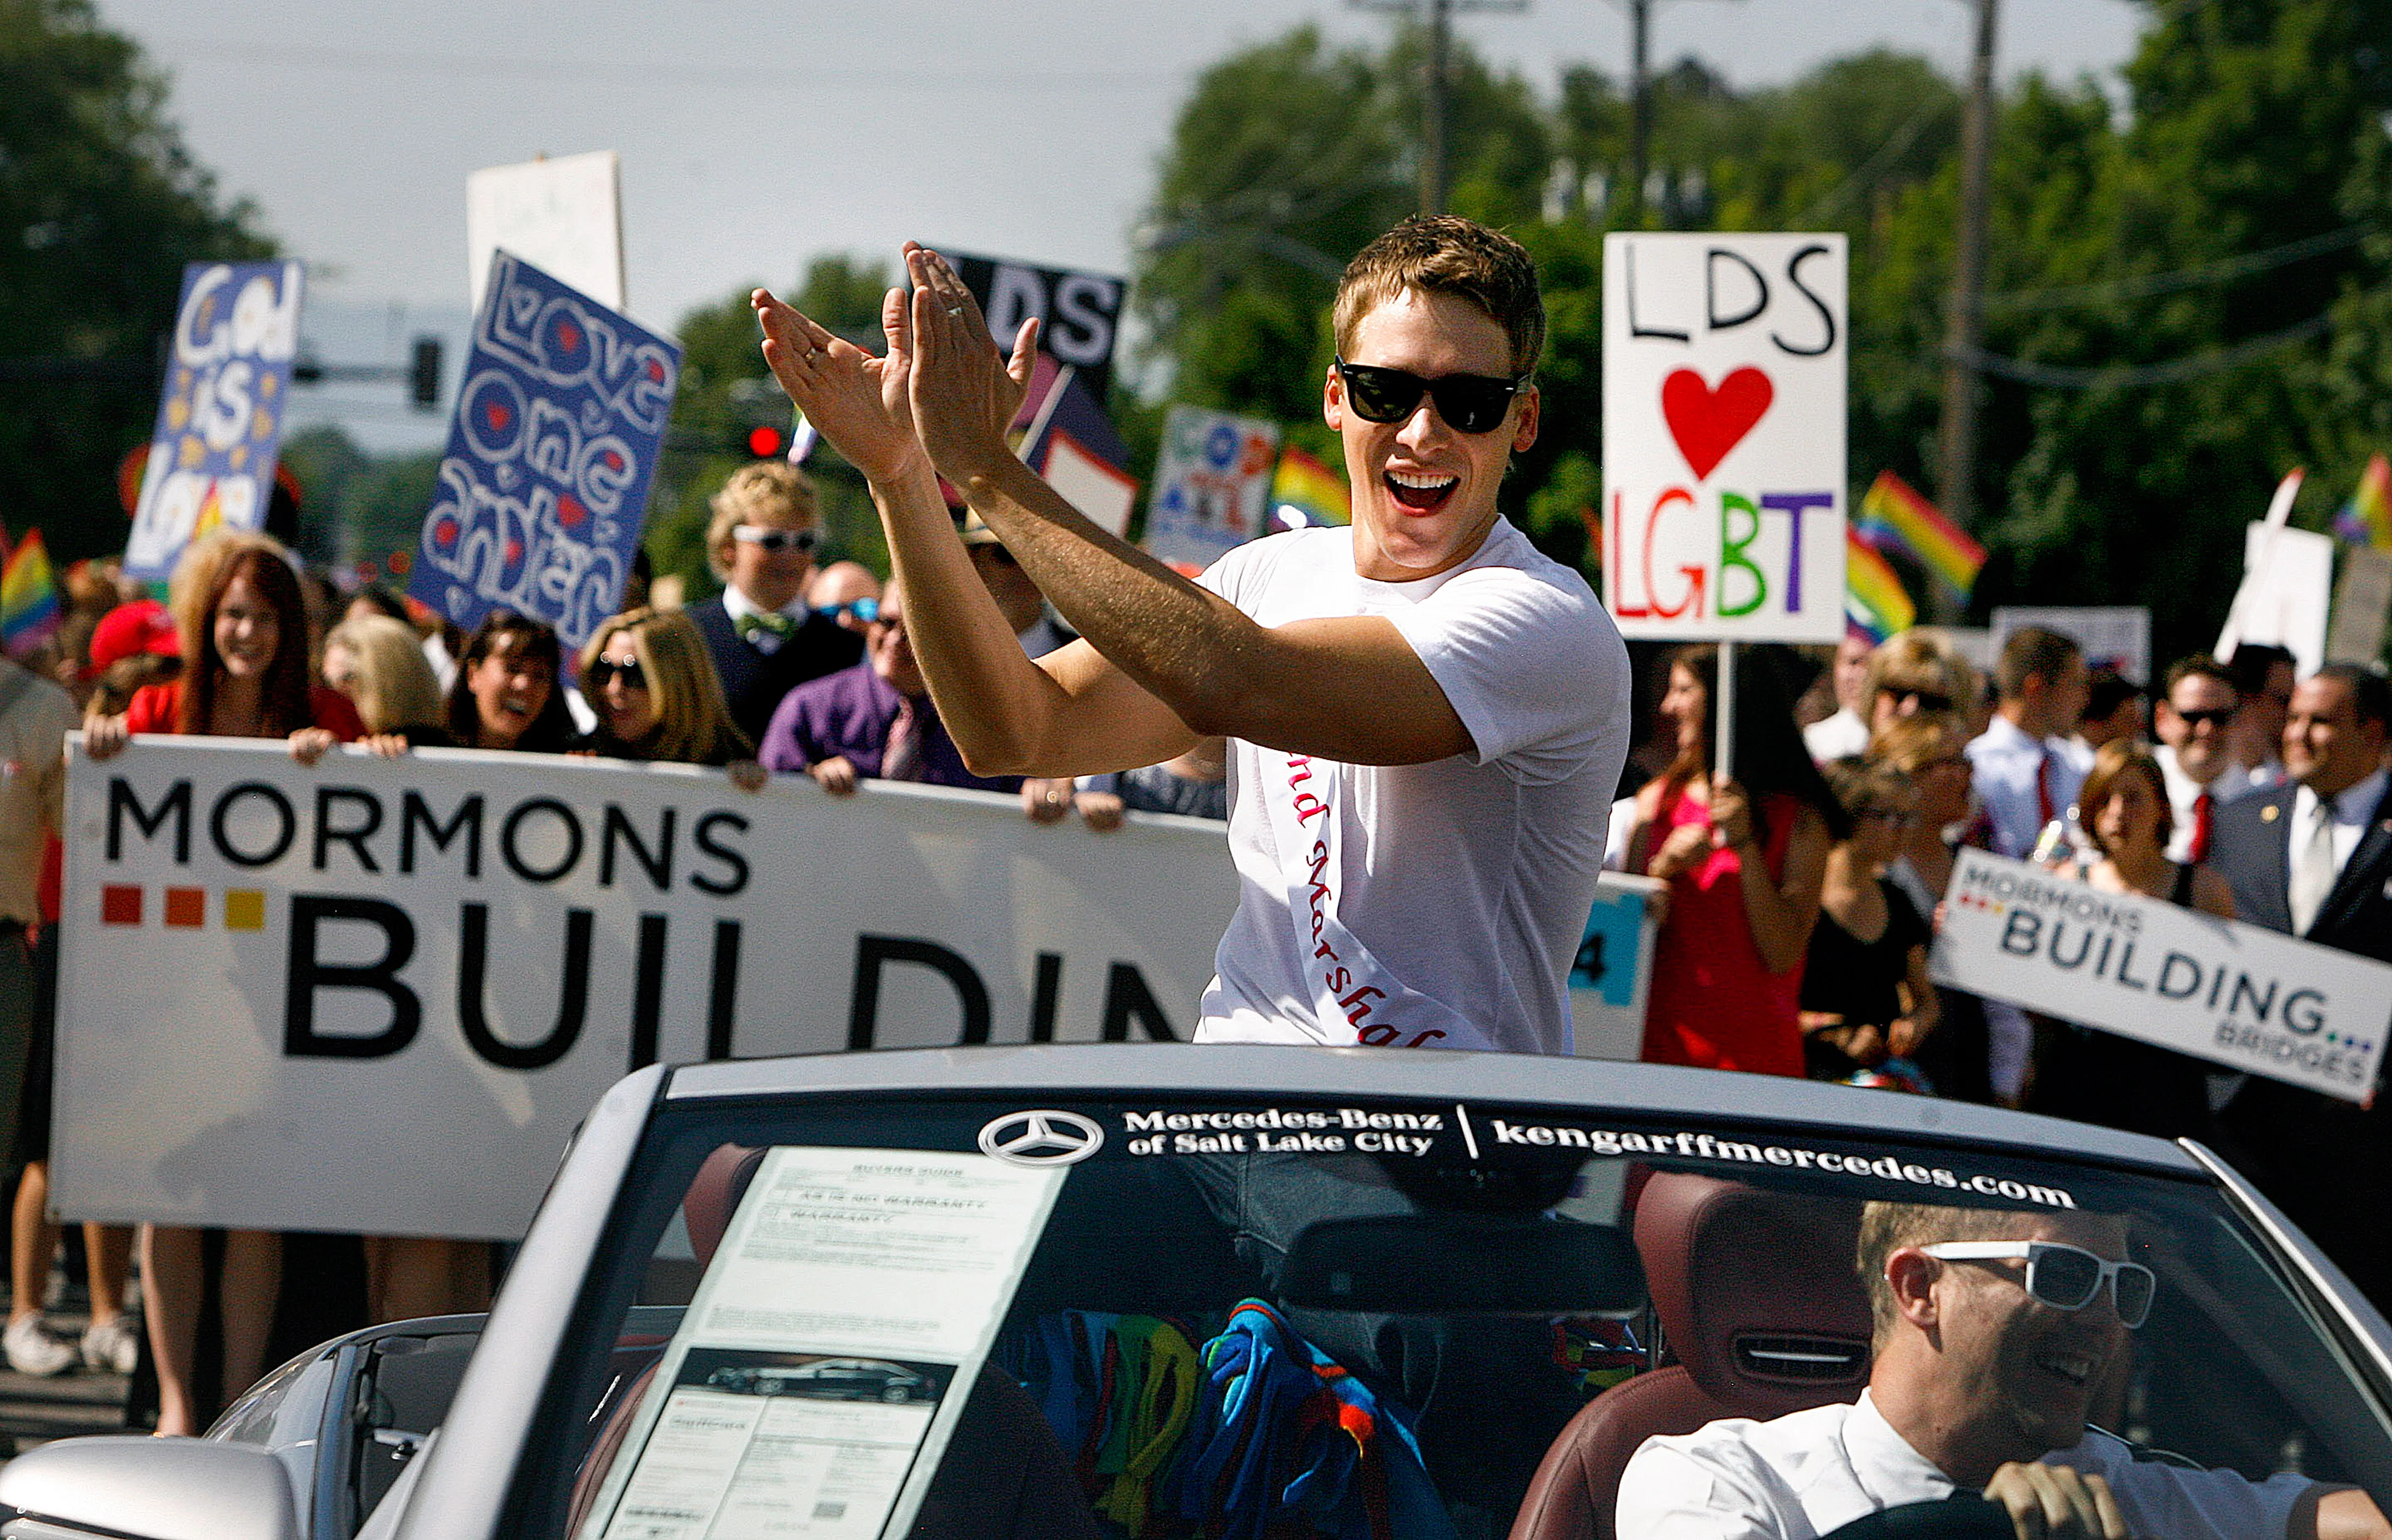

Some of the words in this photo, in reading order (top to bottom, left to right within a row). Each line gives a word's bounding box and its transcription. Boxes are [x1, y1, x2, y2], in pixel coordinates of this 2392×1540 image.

[945, 254, 1121, 367] DS
[1625, 242, 1834, 357] LDS
[1614, 485, 1834, 620] LGBT
[105, 777, 752, 897] MORMONS
[1961, 866, 2142, 936] MORMONS
[2215, 1021, 2372, 1084] BRIDGES
[1122, 1108, 1444, 1132] Mercedes-Benz
[1128, 1133, 1168, 1156] of
[1173, 1132, 1249, 1154] Salt
[1255, 1131, 1347, 1152] Lake
[1354, 1132, 1434, 1157] City
[1490, 1119, 2079, 1210] kengarffmercedes.com
